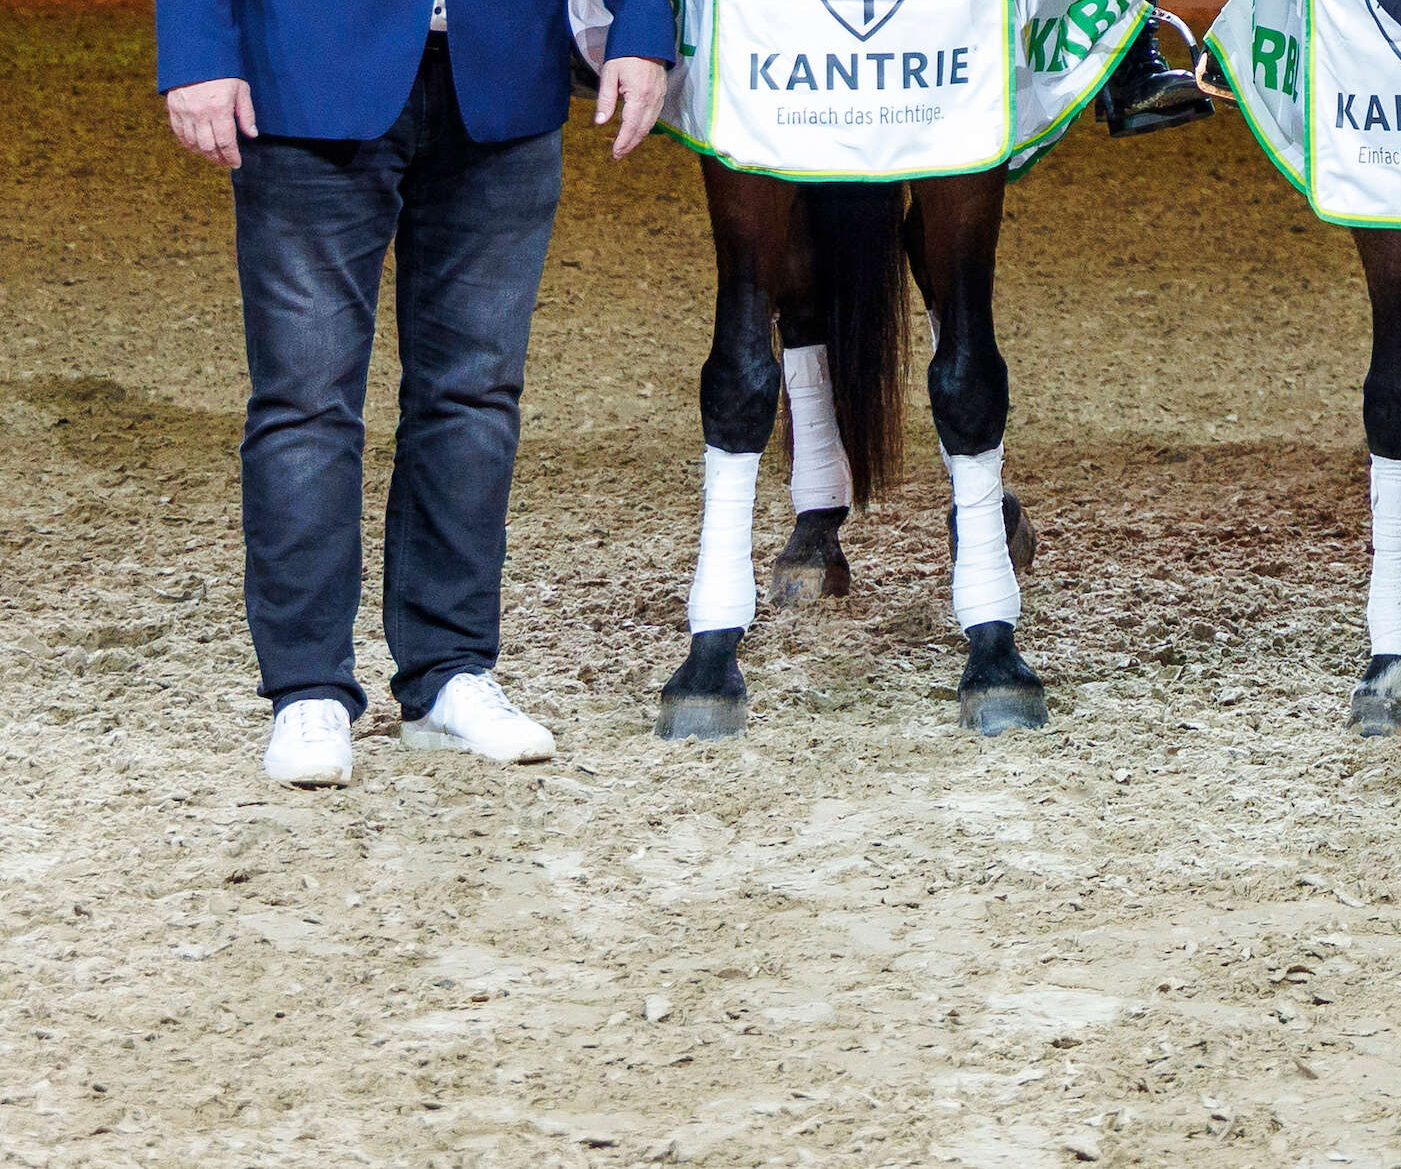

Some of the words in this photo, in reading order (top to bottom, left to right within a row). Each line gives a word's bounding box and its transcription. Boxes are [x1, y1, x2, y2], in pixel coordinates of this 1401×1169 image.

[749, 46, 970, 92] KANTRIE
[776, 106, 838, 126] Einfach
[844, 106, 873, 126] das
[879, 104, 945, 126] Richtige.
